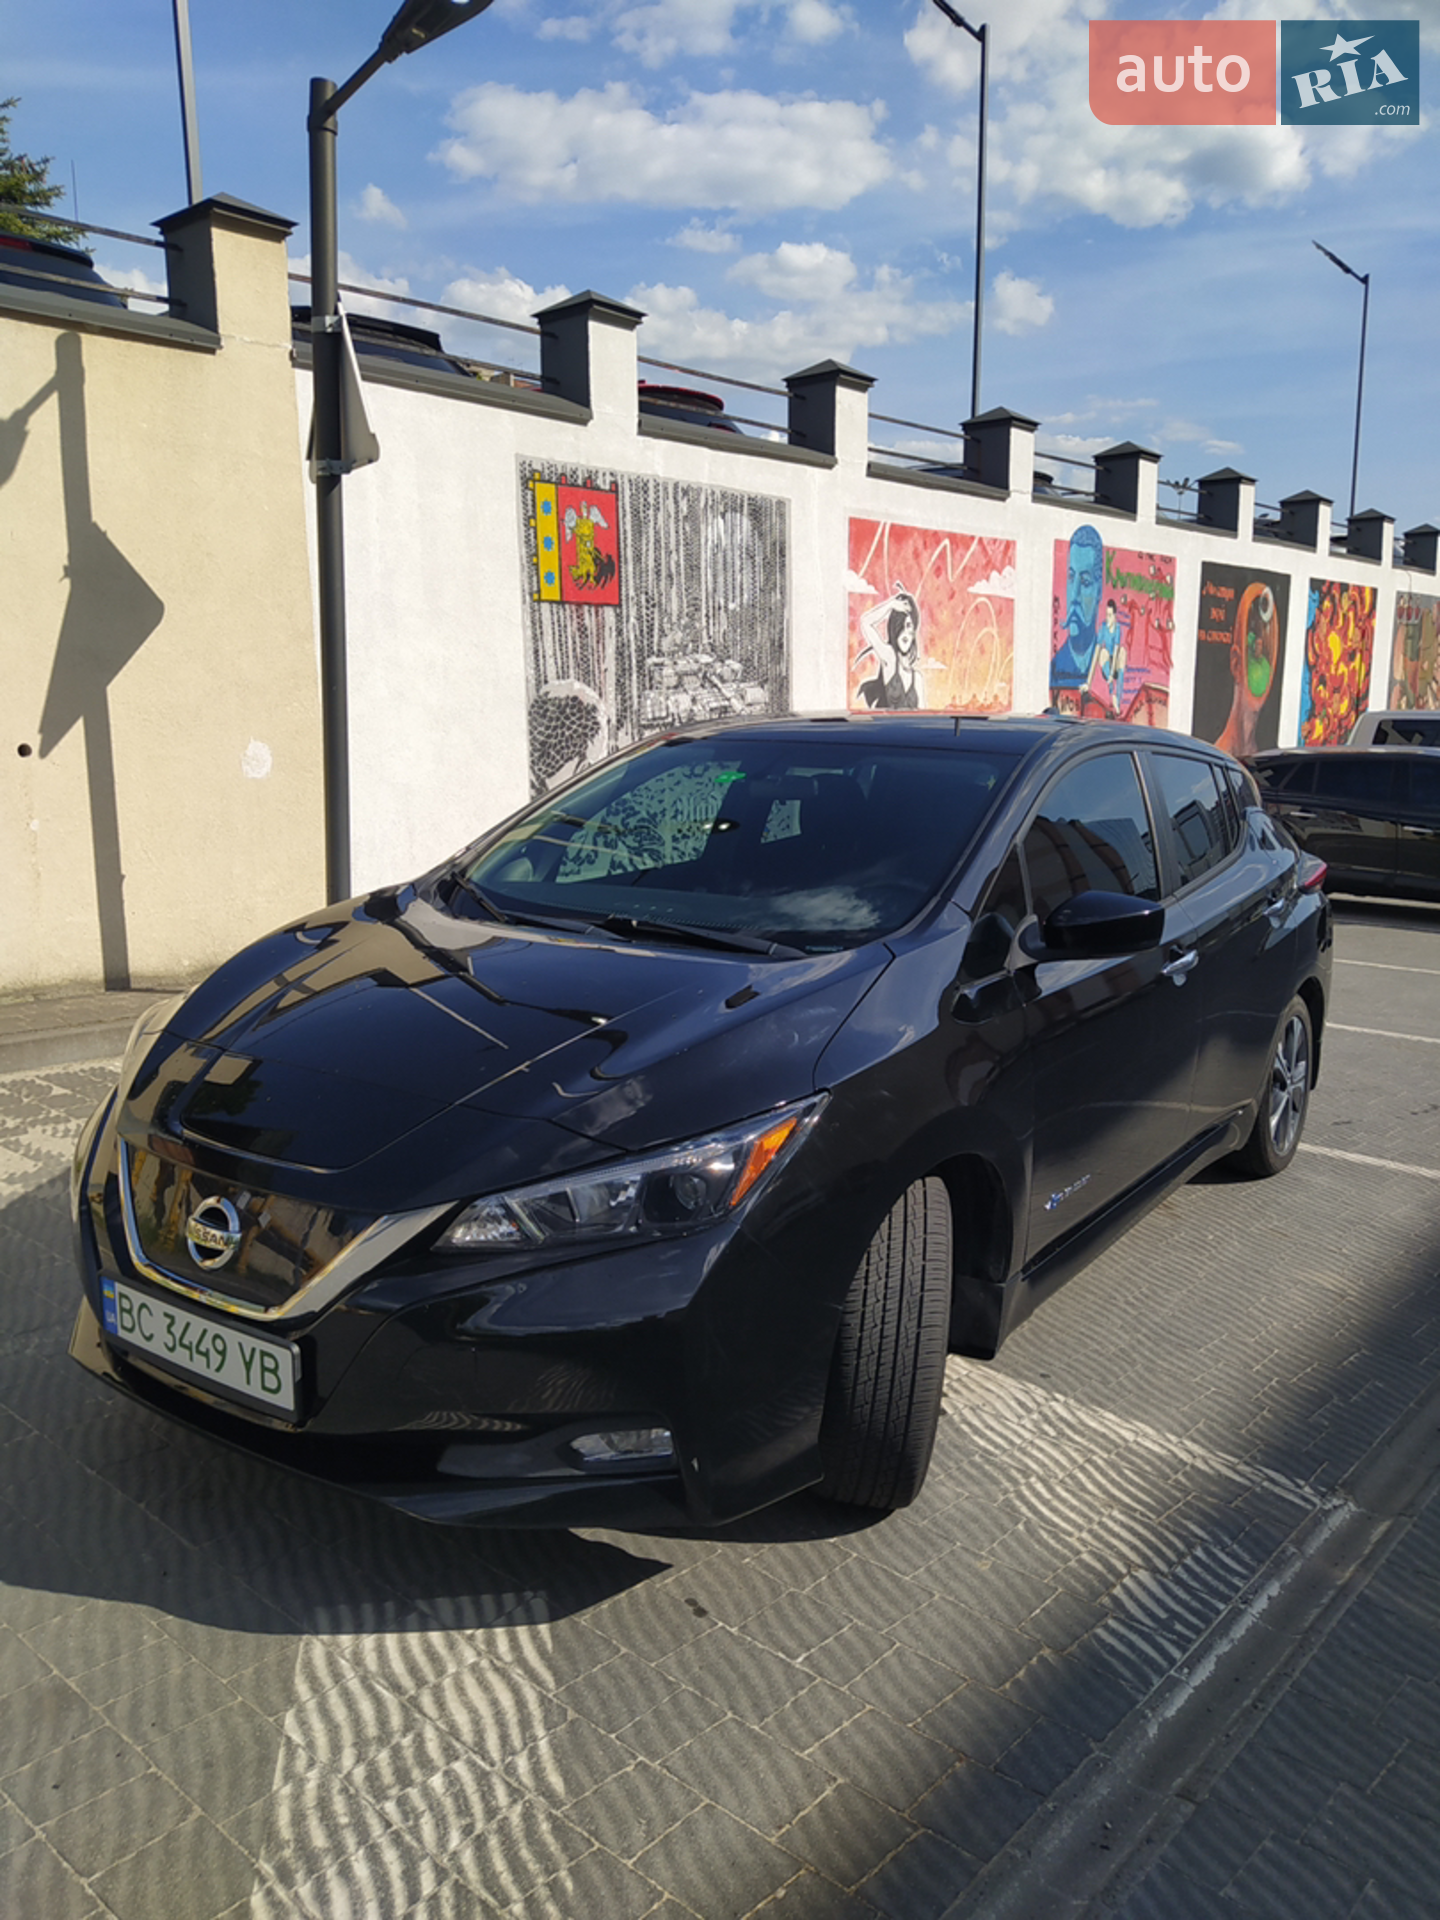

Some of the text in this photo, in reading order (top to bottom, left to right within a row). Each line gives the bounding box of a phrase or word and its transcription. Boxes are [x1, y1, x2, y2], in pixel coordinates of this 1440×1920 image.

[190, 1222, 226, 1246] SSAN
[119, 1291, 282, 1396] BC 3449 YB
